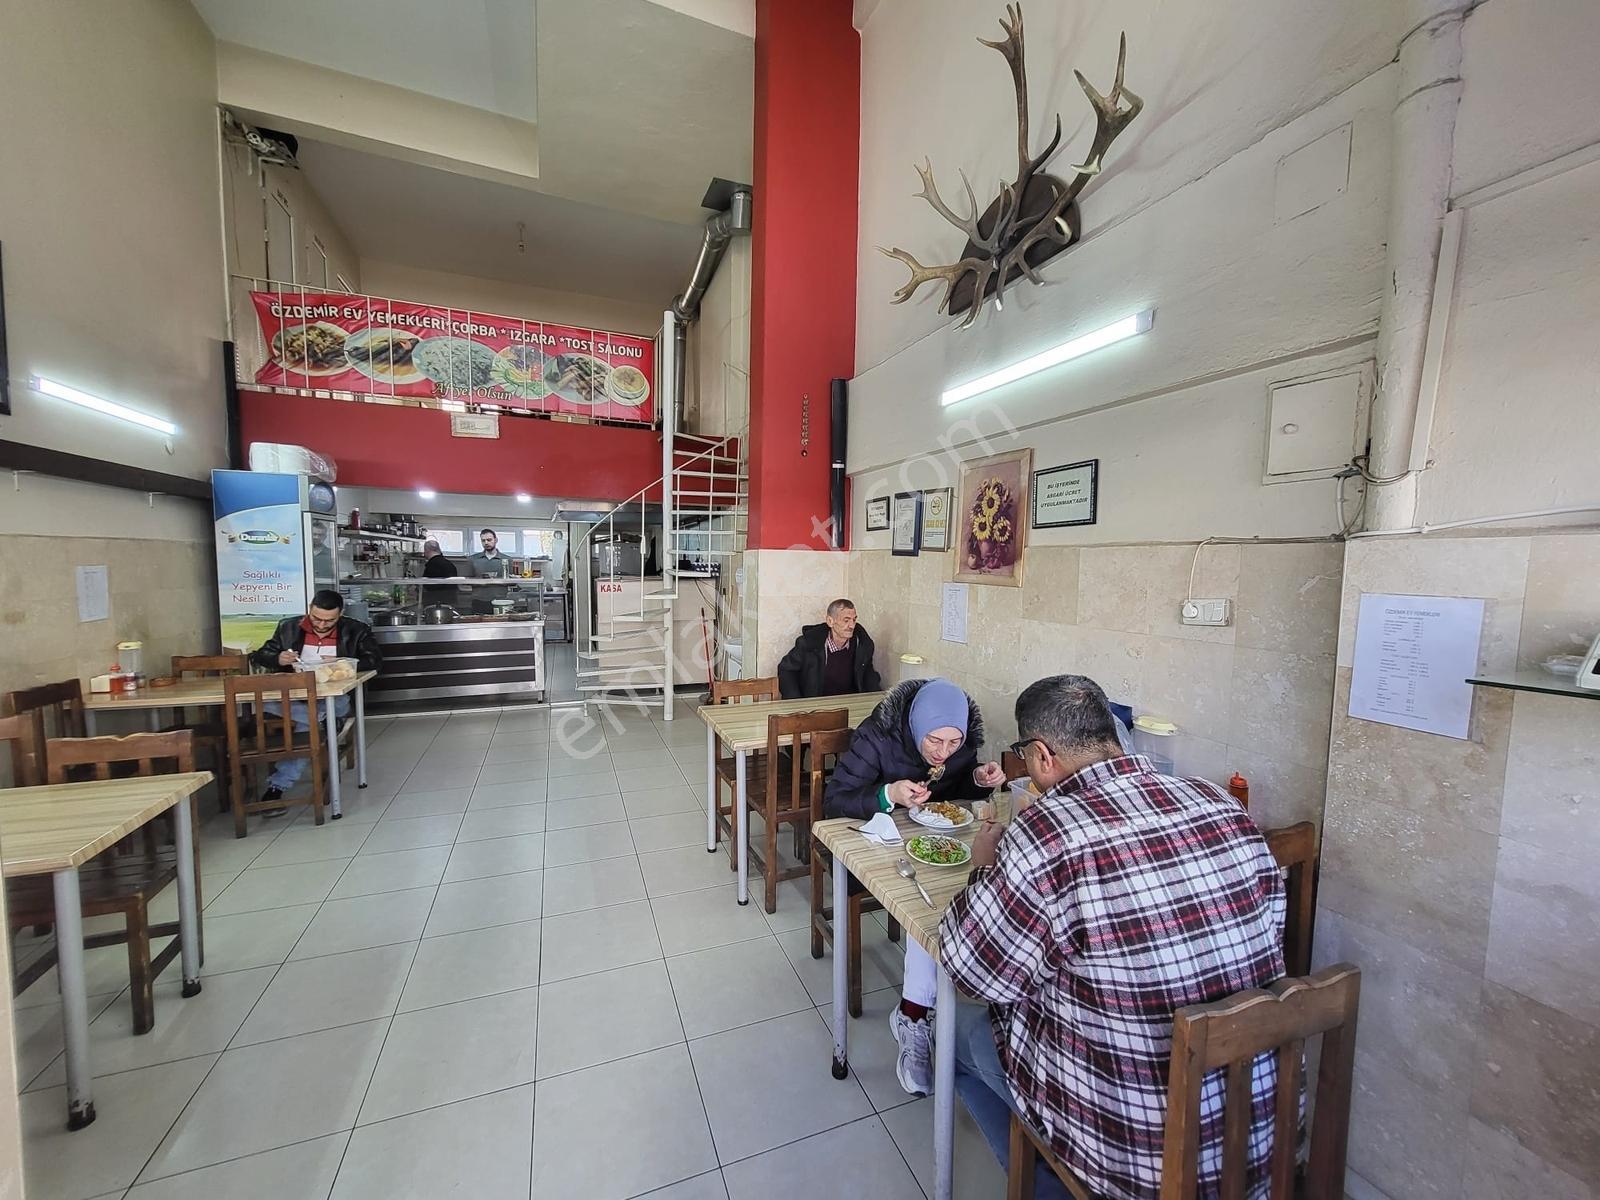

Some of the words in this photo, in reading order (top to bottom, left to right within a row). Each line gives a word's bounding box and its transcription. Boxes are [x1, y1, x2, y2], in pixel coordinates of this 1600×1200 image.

[271, 303, 339, 319] ÖZDEMİR
[343, 308, 363, 320] EV
[510, 330, 557, 346] IZGARA
[597, 343, 643, 359] SALONU
[431, 382, 473, 399] Afye
[476, 384, 514, 401] Olsun
[243, 570, 281, 581] Sağlıklı
[232, 582, 273, 593] Yepyeni
[276, 582, 293, 591] Bir
[600, 584, 622, 593] KASA
[233, 594, 260, 603] Nesil
